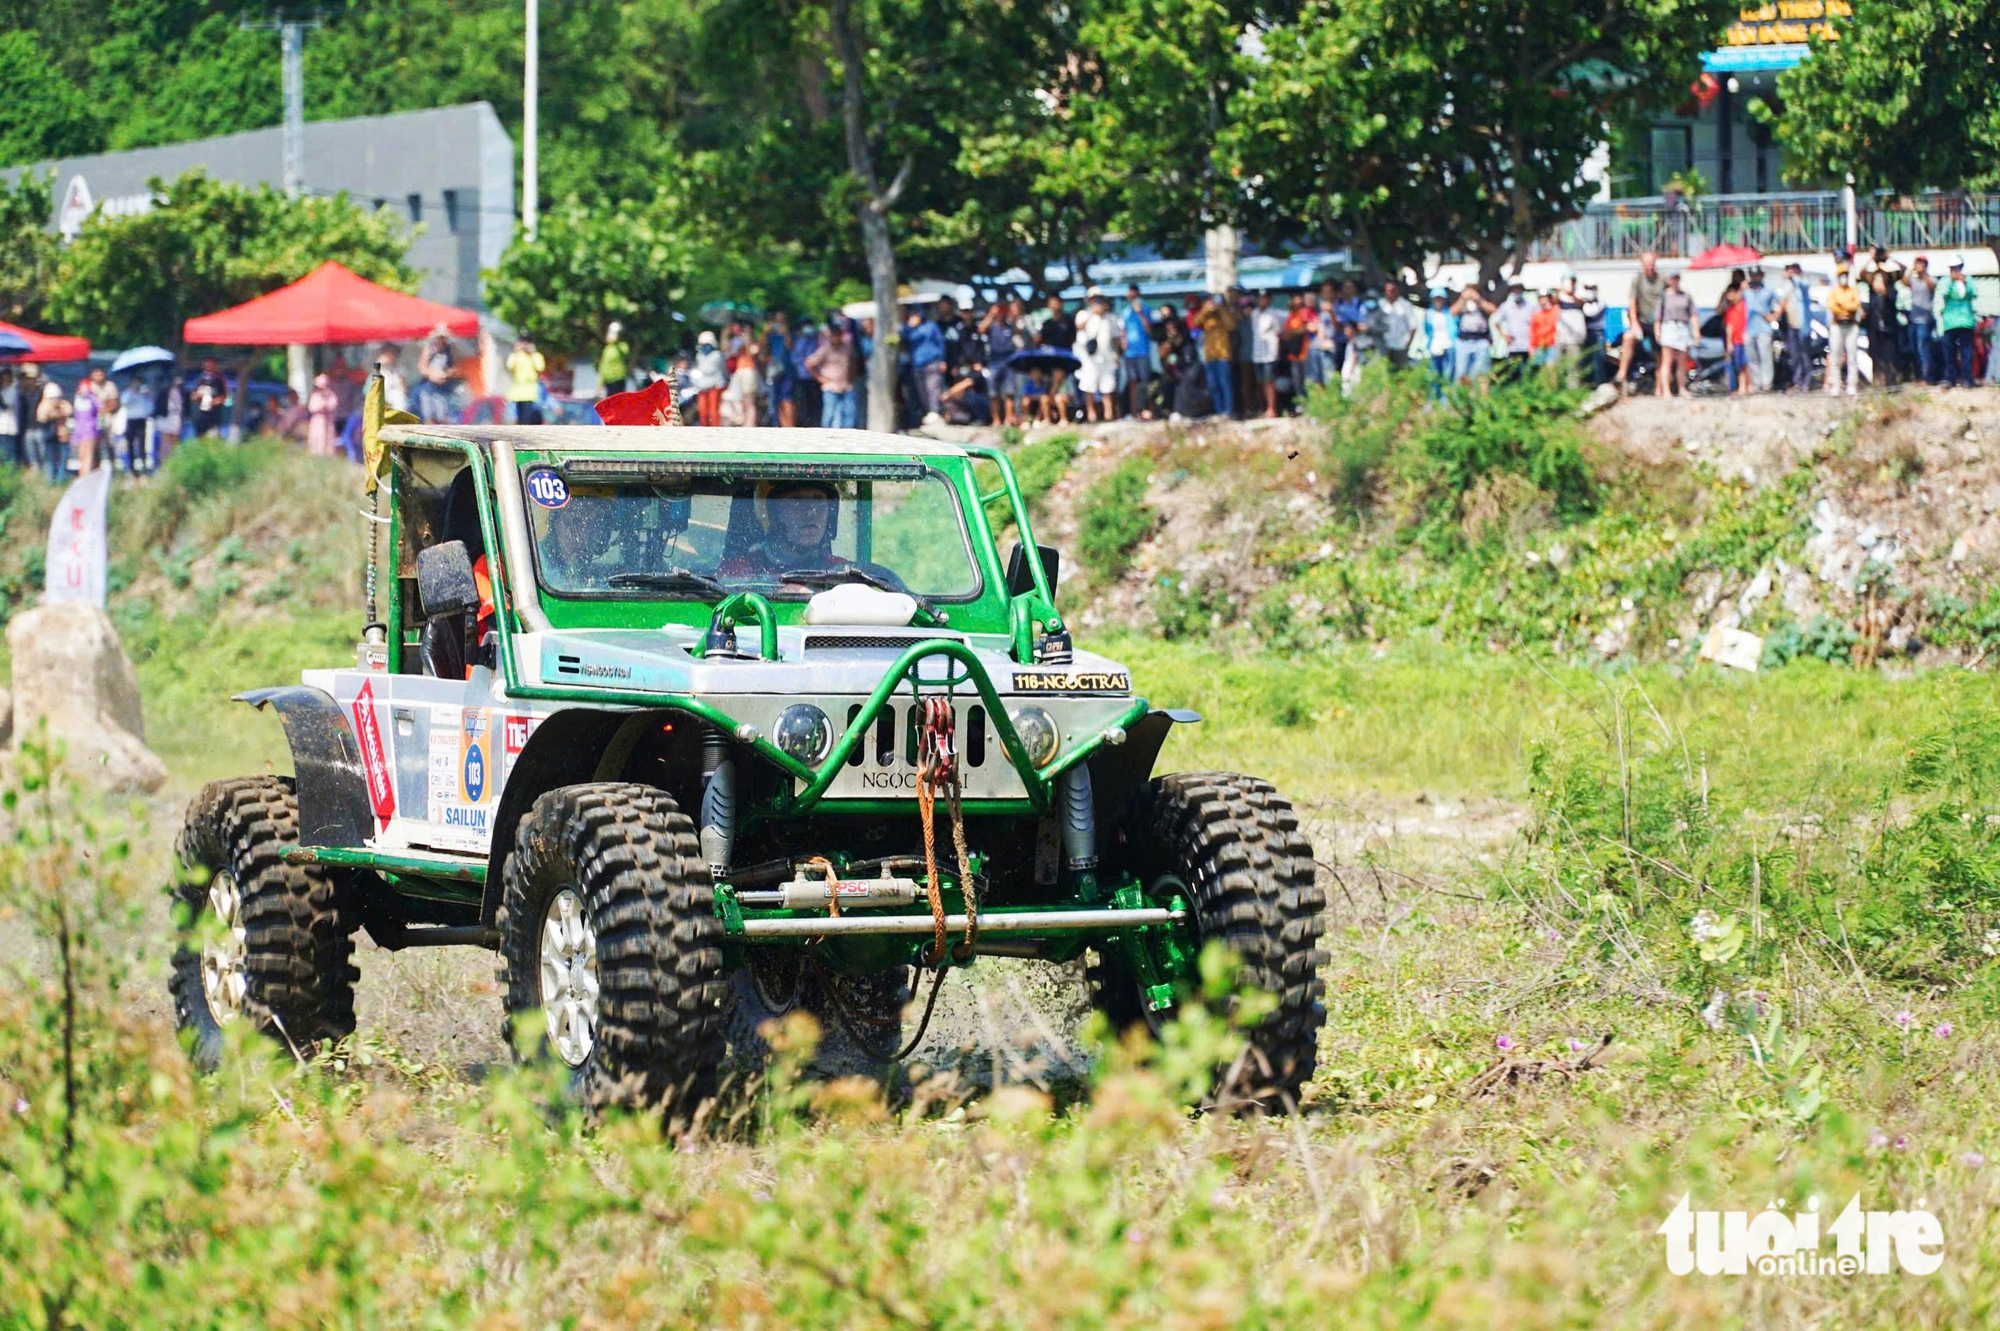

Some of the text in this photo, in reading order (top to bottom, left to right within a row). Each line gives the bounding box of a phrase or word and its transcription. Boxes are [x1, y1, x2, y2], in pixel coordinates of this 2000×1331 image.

[531, 477, 566, 500] 103
[468, 761, 481, 786] 103
[445, 807, 486, 827] SAILUN
[472, 828, 487, 837] TIRE
